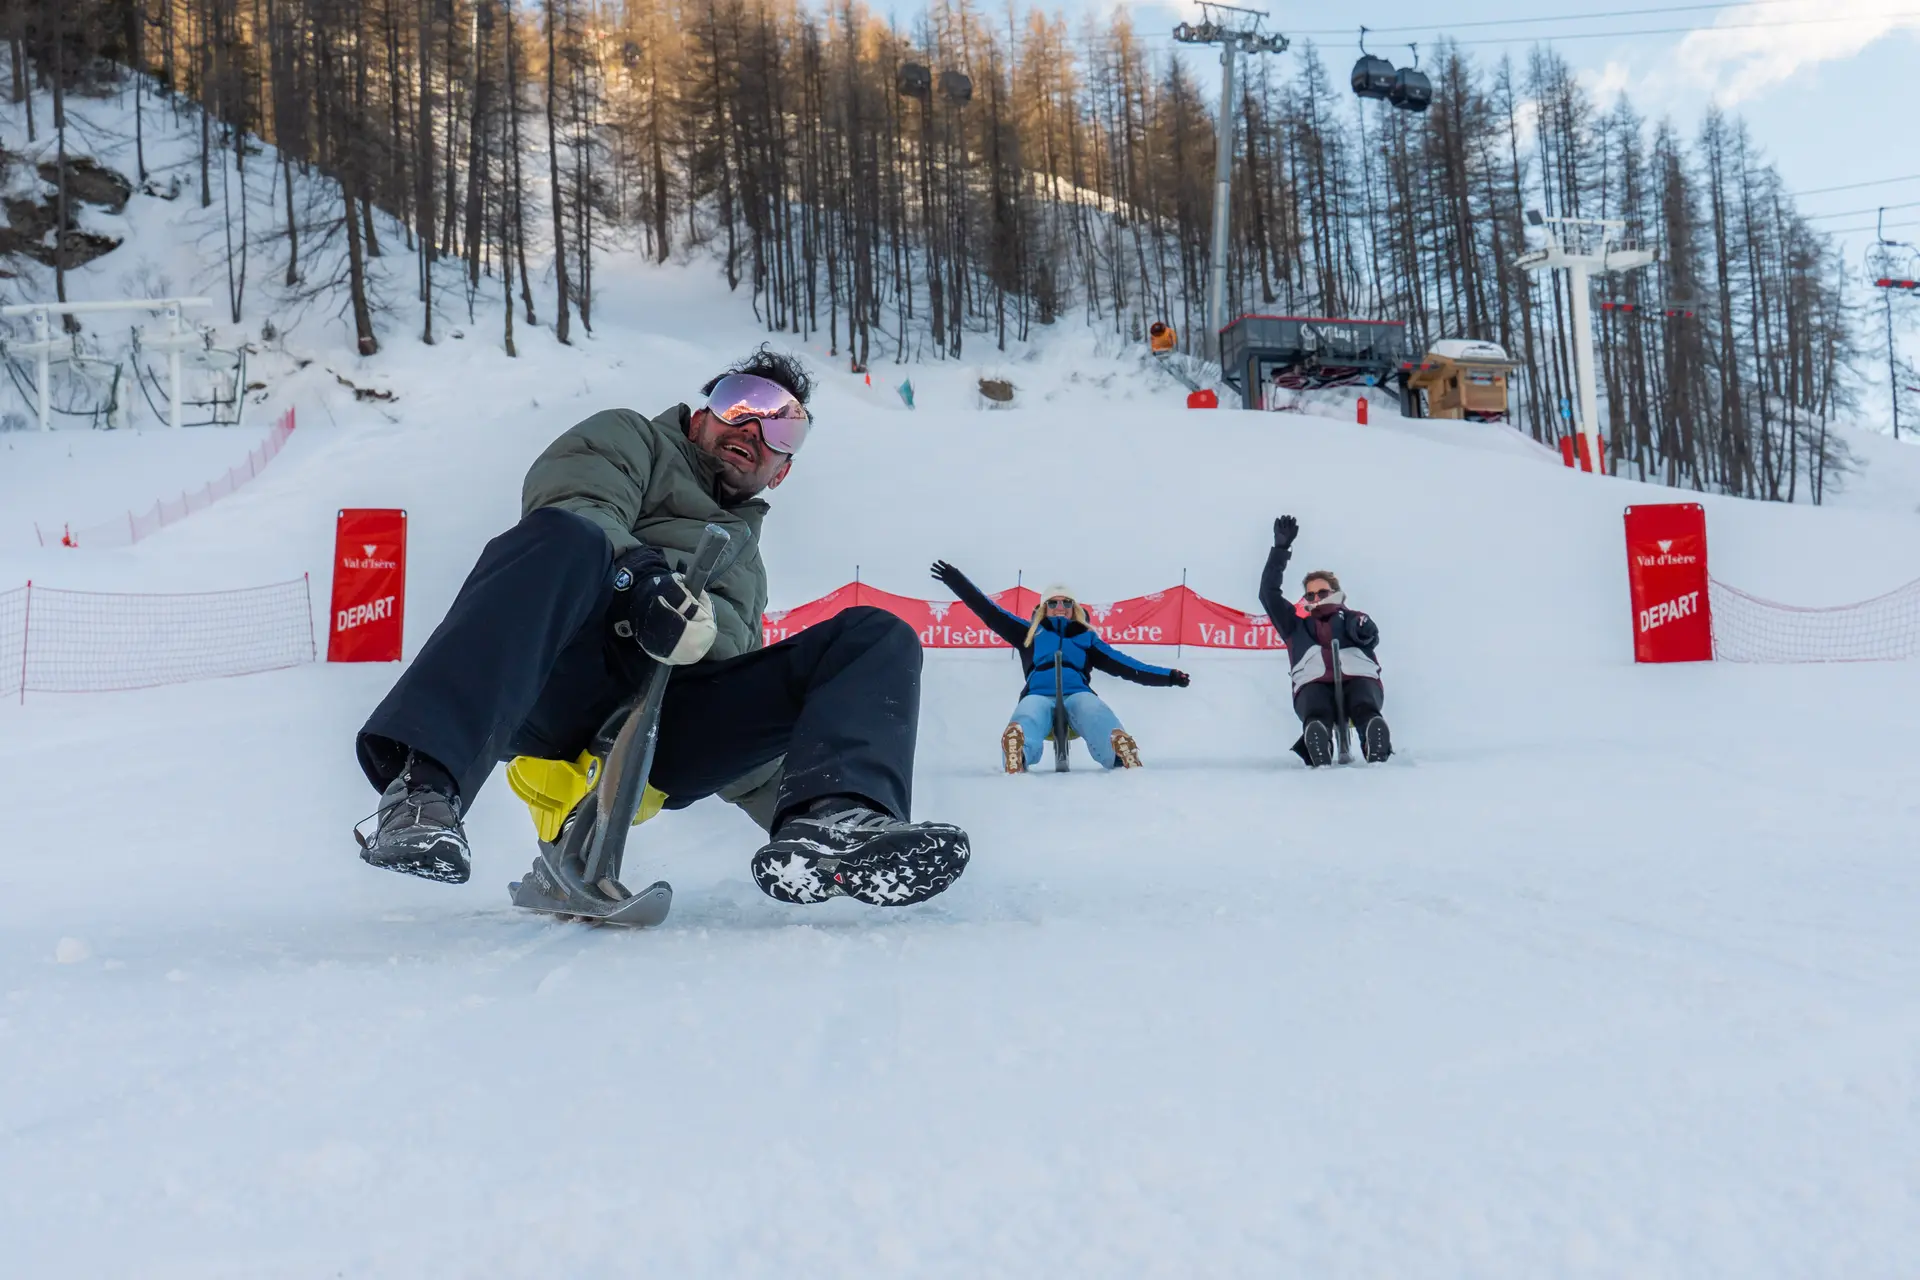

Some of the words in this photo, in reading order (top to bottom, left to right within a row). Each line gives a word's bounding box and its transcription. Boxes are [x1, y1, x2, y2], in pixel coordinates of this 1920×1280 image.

[343, 558, 359, 569] Val
[361, 558, 396, 569] d'Isère
[1637, 555, 1655, 566] Val
[1657, 553, 1696, 565] d'Isère
[337, 595, 395, 632] DEPART
[1640, 591, 1699, 632] DEPART
[920, 625, 1003, 645] d'Isère
[1198, 623, 1236, 645] Val
[1243, 626, 1285, 647] d'Is
